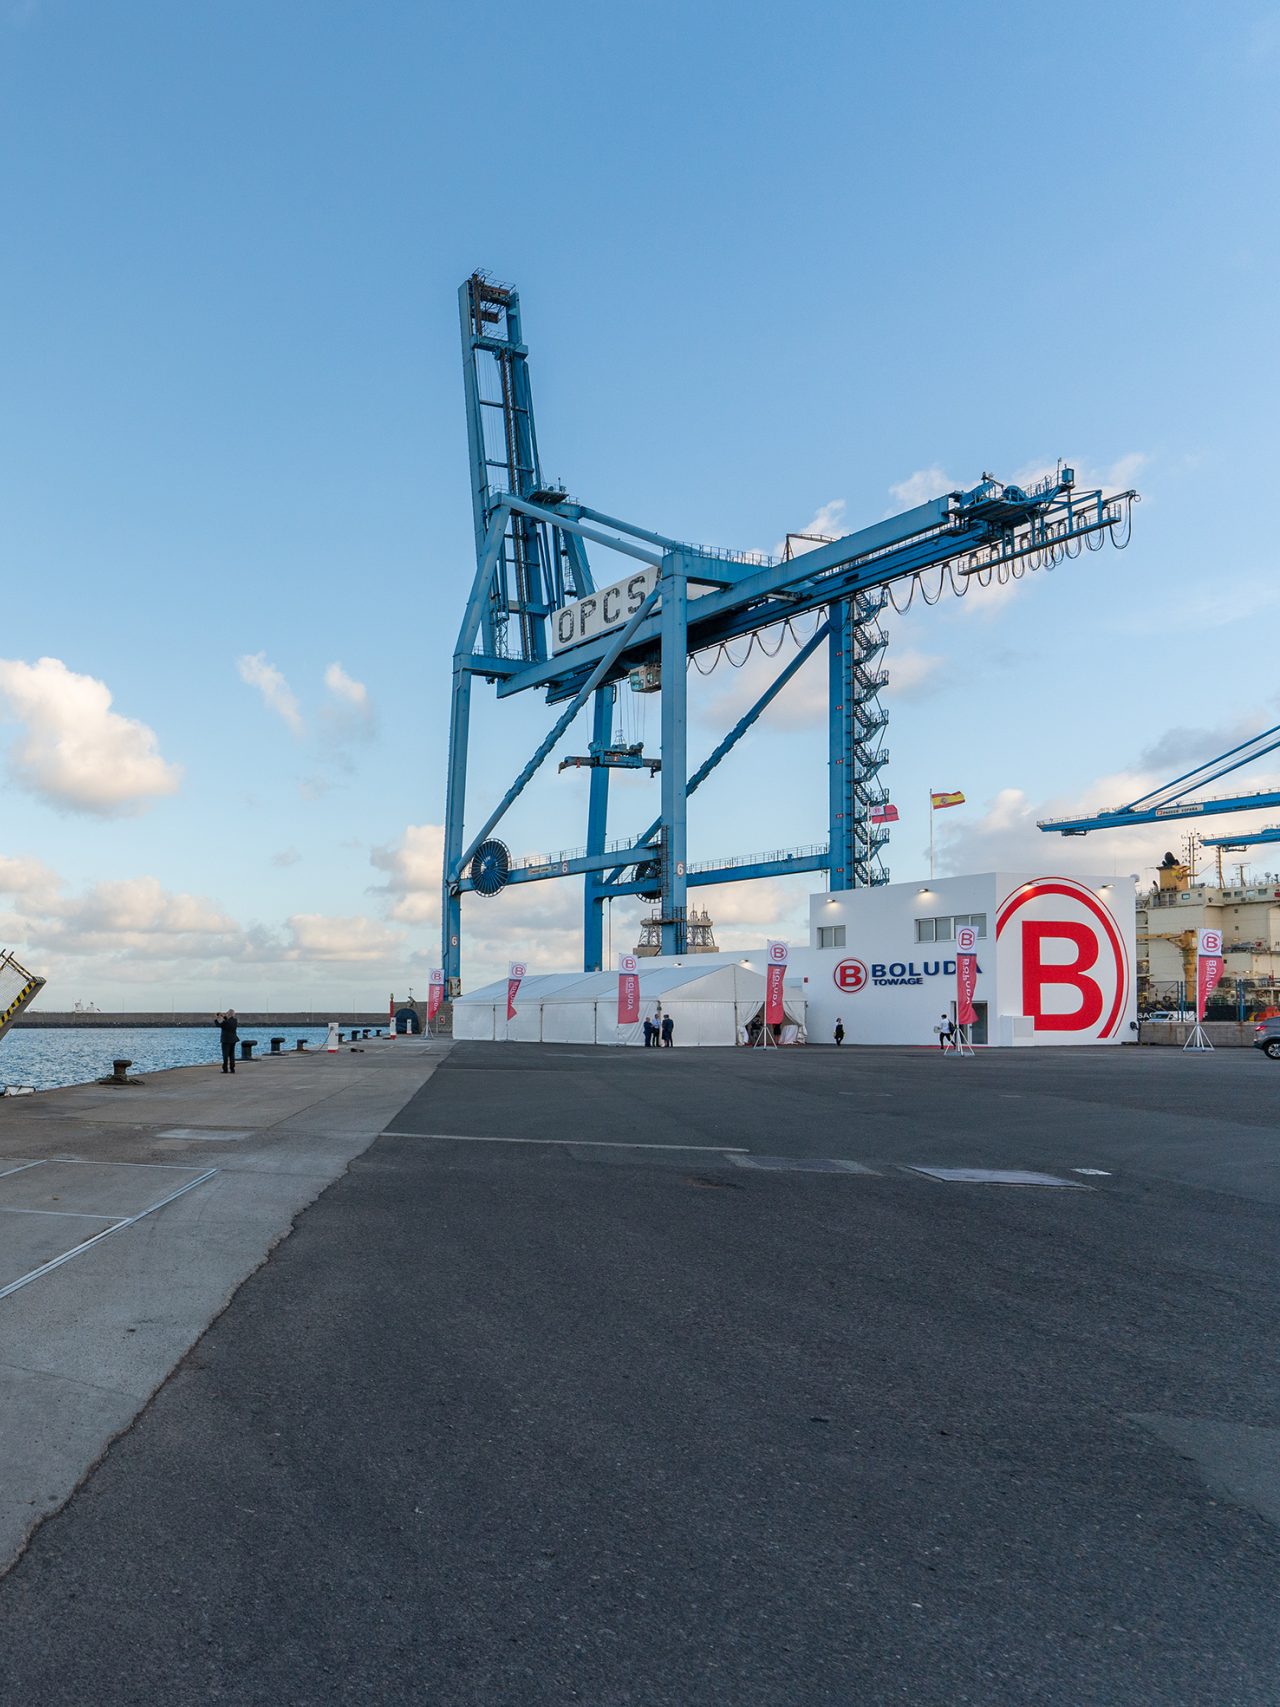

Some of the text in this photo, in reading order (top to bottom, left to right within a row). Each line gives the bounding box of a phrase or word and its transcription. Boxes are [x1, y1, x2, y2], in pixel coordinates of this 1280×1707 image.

[558, 567, 662, 644] OPCS
[677, 863, 684, 875] 6
[451, 936, 458, 946] 6
[772, 968, 781, 1007] BOLUDA
[839, 965, 862, 987] B
[872, 977, 924, 986] TOWAGE
[1022, 920, 1104, 1031] B
[627, 976, 635, 1010] BOLUDA
